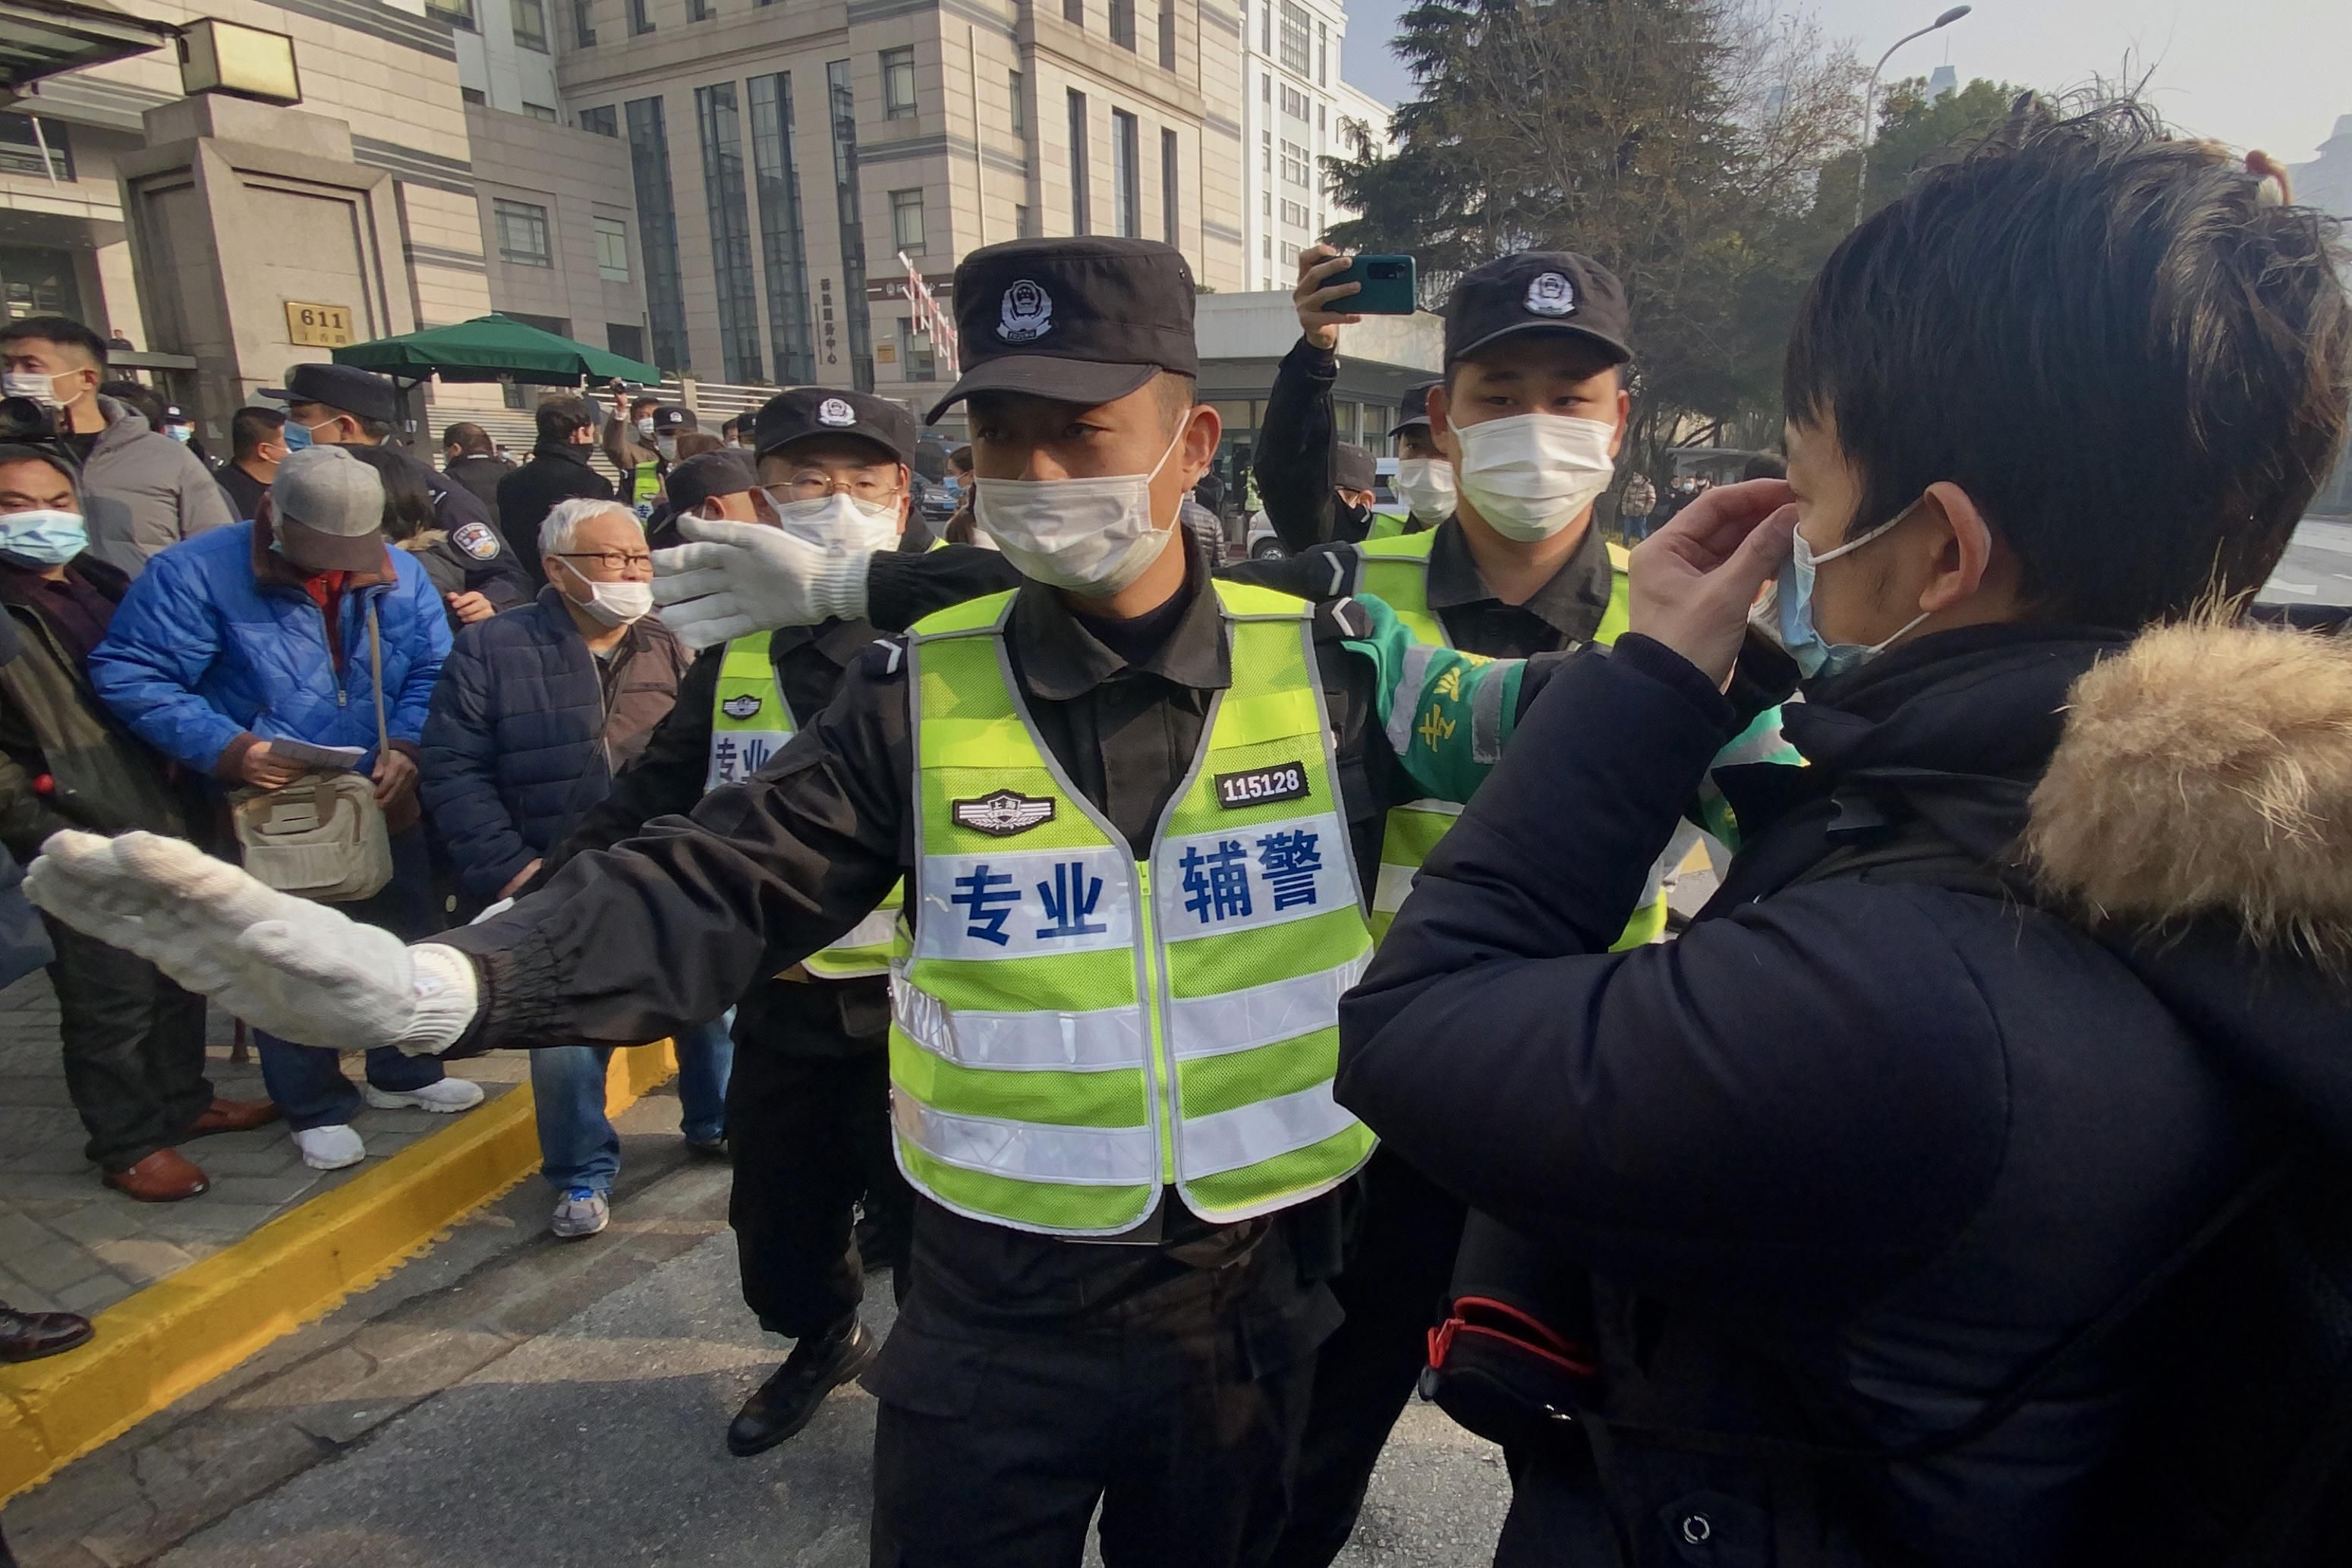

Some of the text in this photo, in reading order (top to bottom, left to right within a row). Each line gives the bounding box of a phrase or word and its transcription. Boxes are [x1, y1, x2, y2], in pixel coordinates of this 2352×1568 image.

[301, 309, 344, 329] 611
[716, 737, 770, 784] 专业
[1223, 769, 1299, 801] 115128
[950, 828, 1323, 946] 专业 辅警
